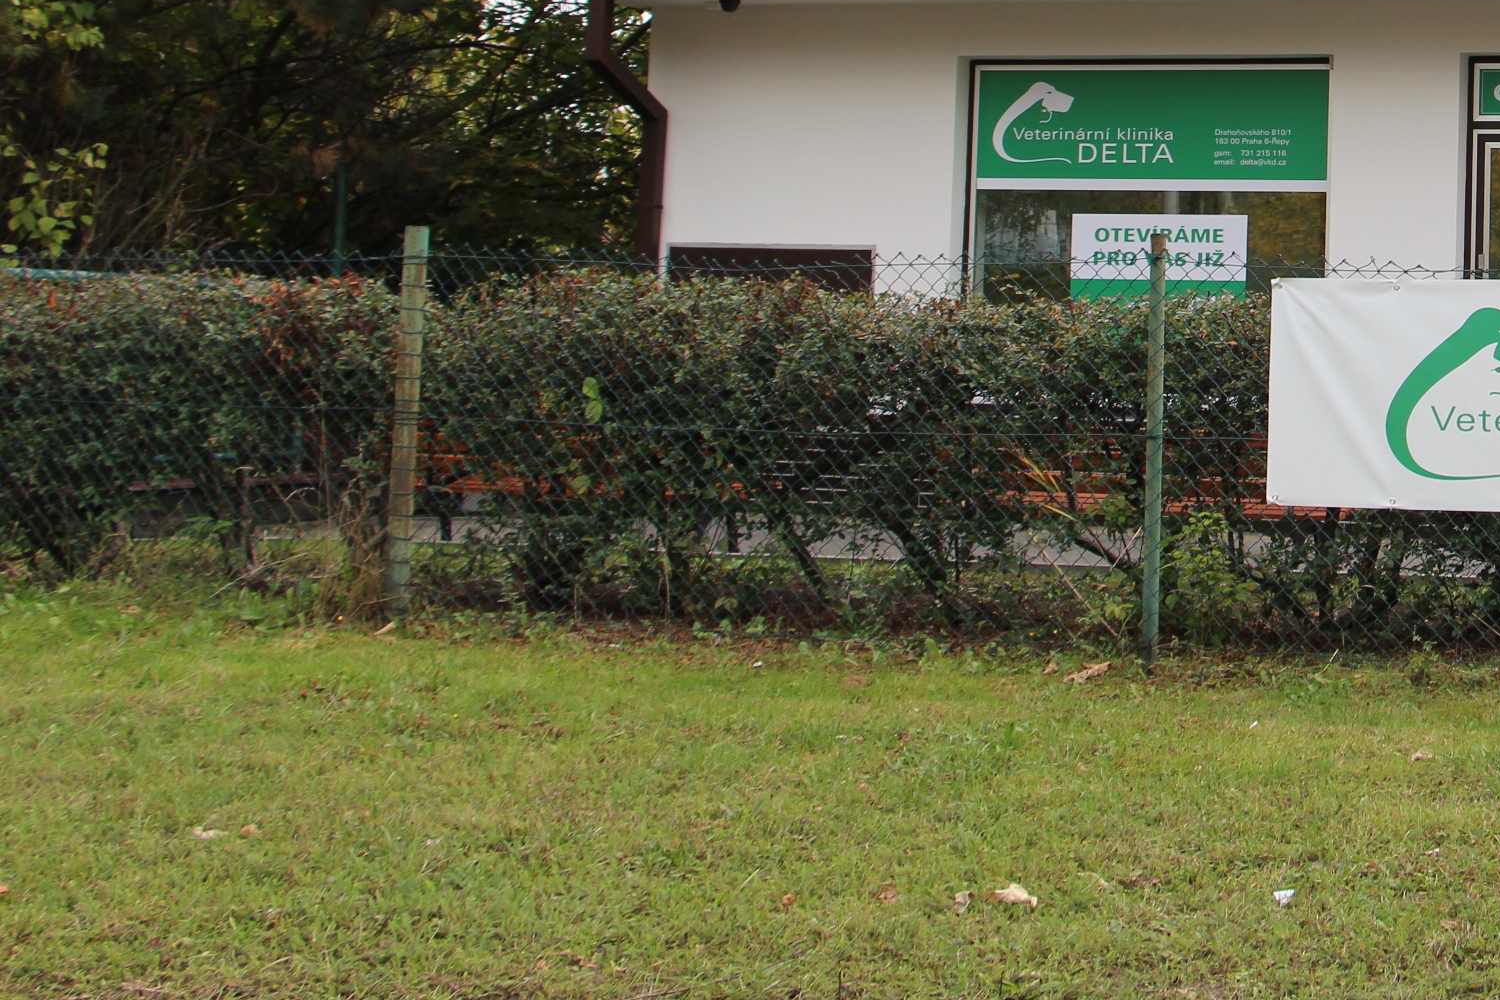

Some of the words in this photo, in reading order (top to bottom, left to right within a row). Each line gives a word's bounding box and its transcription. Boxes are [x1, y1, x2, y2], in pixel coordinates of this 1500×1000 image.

[1013, 126, 1111, 141] Veterinární
[1117, 126, 1174, 141] klinika
[1264, 137, 1290, 146] 6-Řepy
[1078, 142, 1174, 164] DELTA
[1213, 150, 1232, 158] gsm:
[1240, 149, 1254, 157] 731
[1256, 149, 1271, 157] 215
[1272, 149, 1287, 157] 116
[1213, 158, 1235, 166] email:
[1240, 158, 1287, 167] delta@vkd.cz
[1094, 225, 1225, 244] OTEVÍRÁME
[1093, 251, 1137, 266] PRO
[1193, 249, 1225, 268] JIŽ
